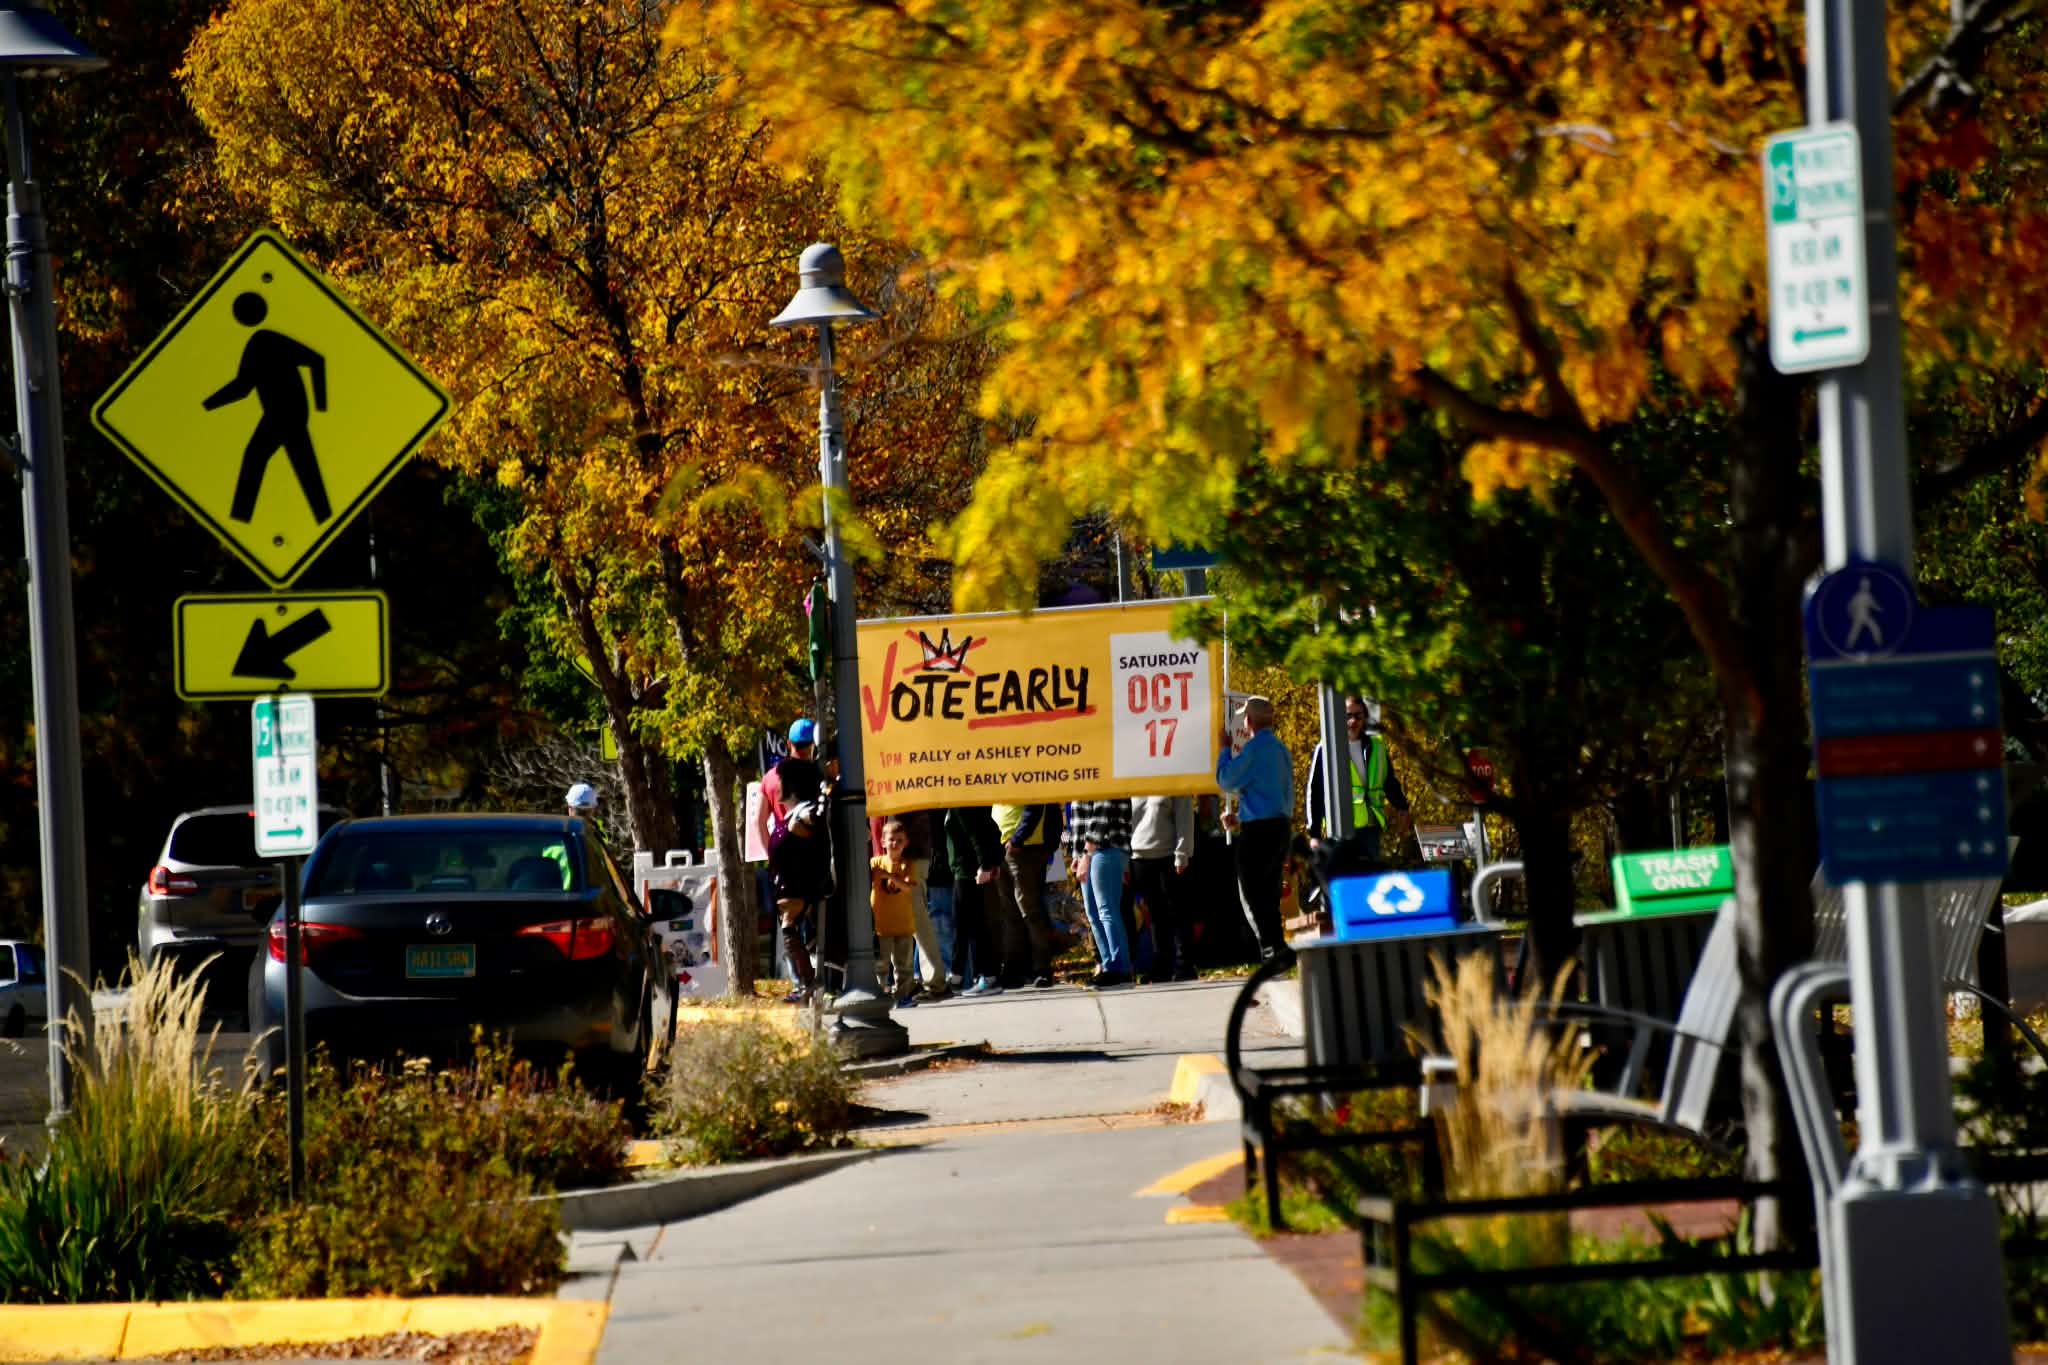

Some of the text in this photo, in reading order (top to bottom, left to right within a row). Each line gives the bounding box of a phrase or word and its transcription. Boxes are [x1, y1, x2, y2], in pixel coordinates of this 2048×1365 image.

[1119, 652, 1199, 669] SATURDAY
[862, 640, 1088, 734] VOTE EARLY
[1127, 672, 1193, 714] OCT
[1145, 718, 1178, 757] 17
[909, 749, 952, 764] RALLY
[956, 750, 971, 760] at
[975, 745, 1031, 760] ASHLEY
[1036, 744, 1081, 757] POND
[896, 775, 944, 792] MARCH
[948, 776, 961, 786] to
[965, 774, 1008, 786] EARLY
[1011, 769, 1069, 784] VOTING
[1073, 768, 1100, 780] SITE
[1470, 764, 1492, 777] TOP
[1640, 852, 1719, 876] TRASH
[1651, 871, 1713, 891] ONLY
